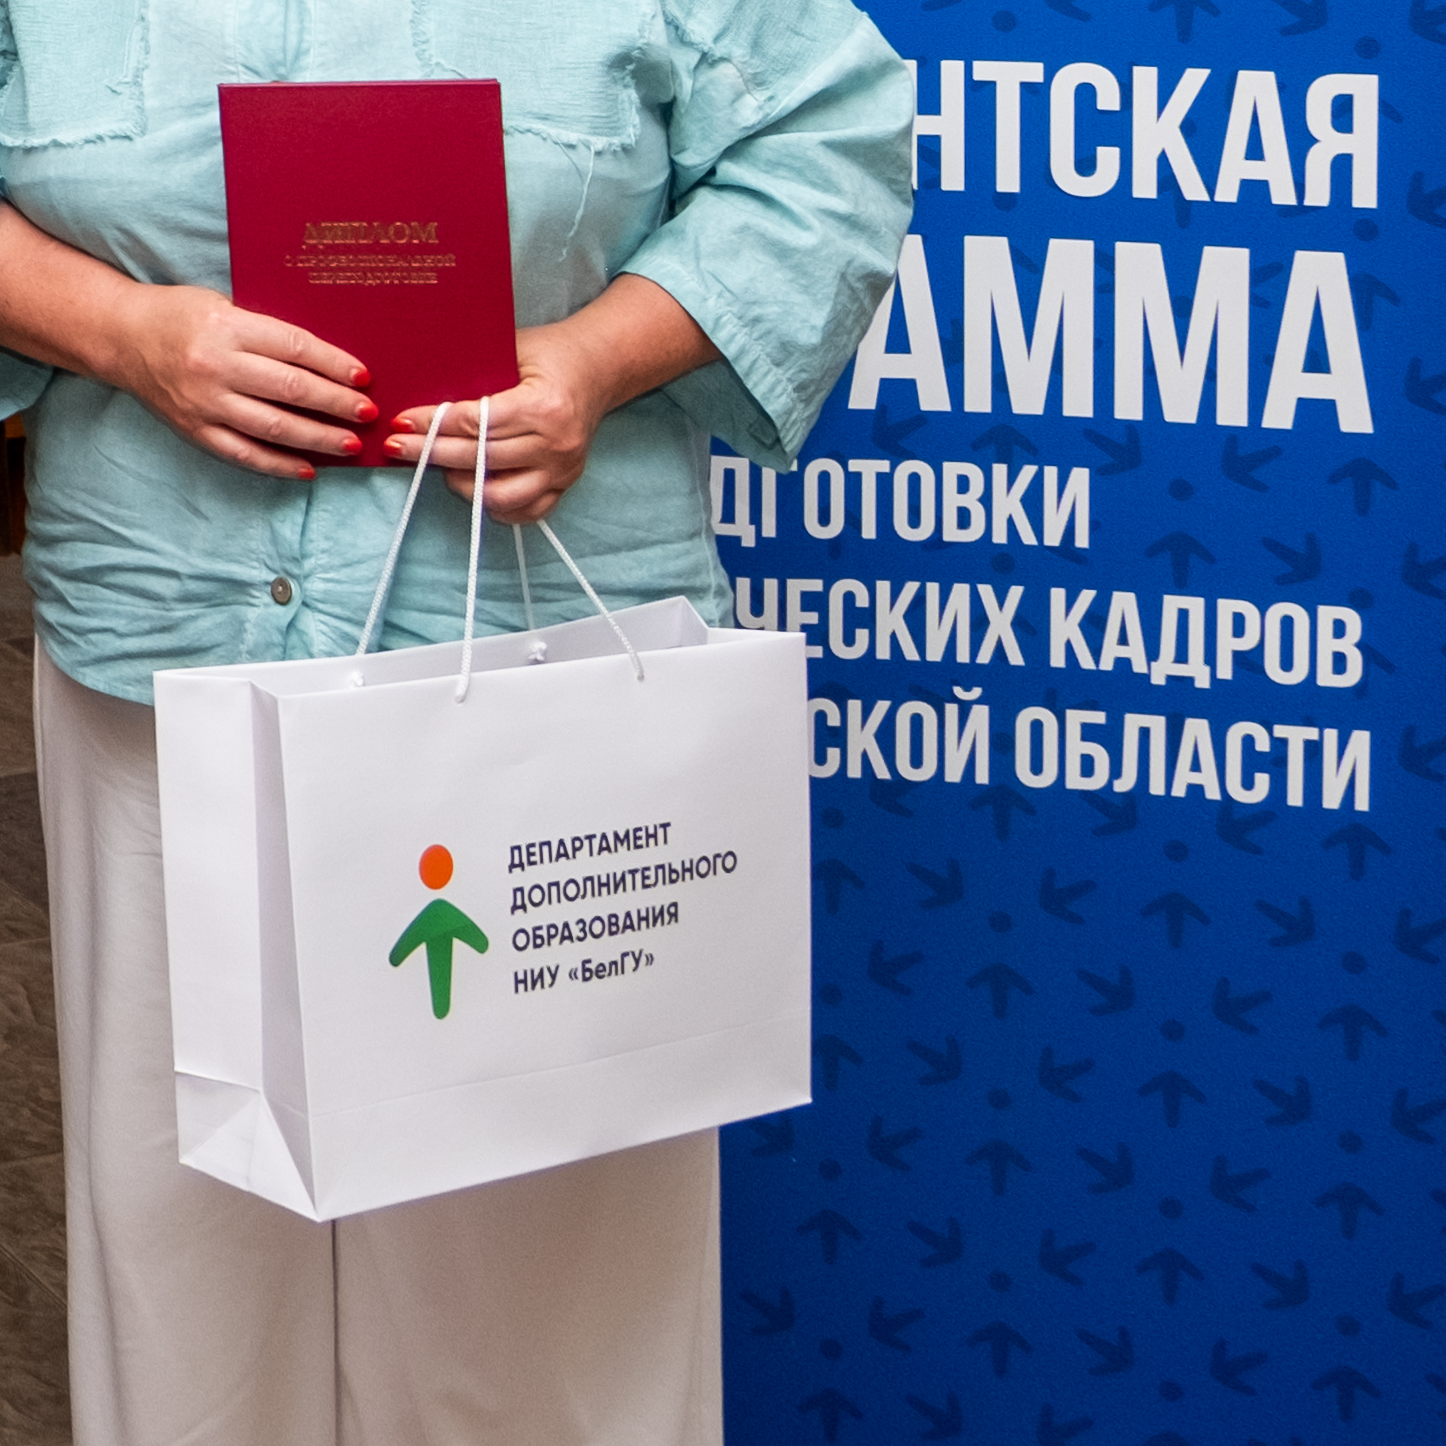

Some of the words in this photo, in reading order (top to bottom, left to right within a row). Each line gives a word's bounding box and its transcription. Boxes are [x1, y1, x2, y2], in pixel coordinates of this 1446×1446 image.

[1049, 587, 1365, 690] КАДРОВ
[1014, 705, 1372, 814] ОБЛАСТИ
[508, 821, 672, 874] ДЕПАРТАМЕНТ
[510, 850, 738, 915] ДОПОЛНИТЕЛЬНОГО
[511, 901, 679, 952] ОБРАЗОВАНИЯ
[513, 964, 560, 994] НИУ
[567, 948, 655, 984] «БелГУ»
